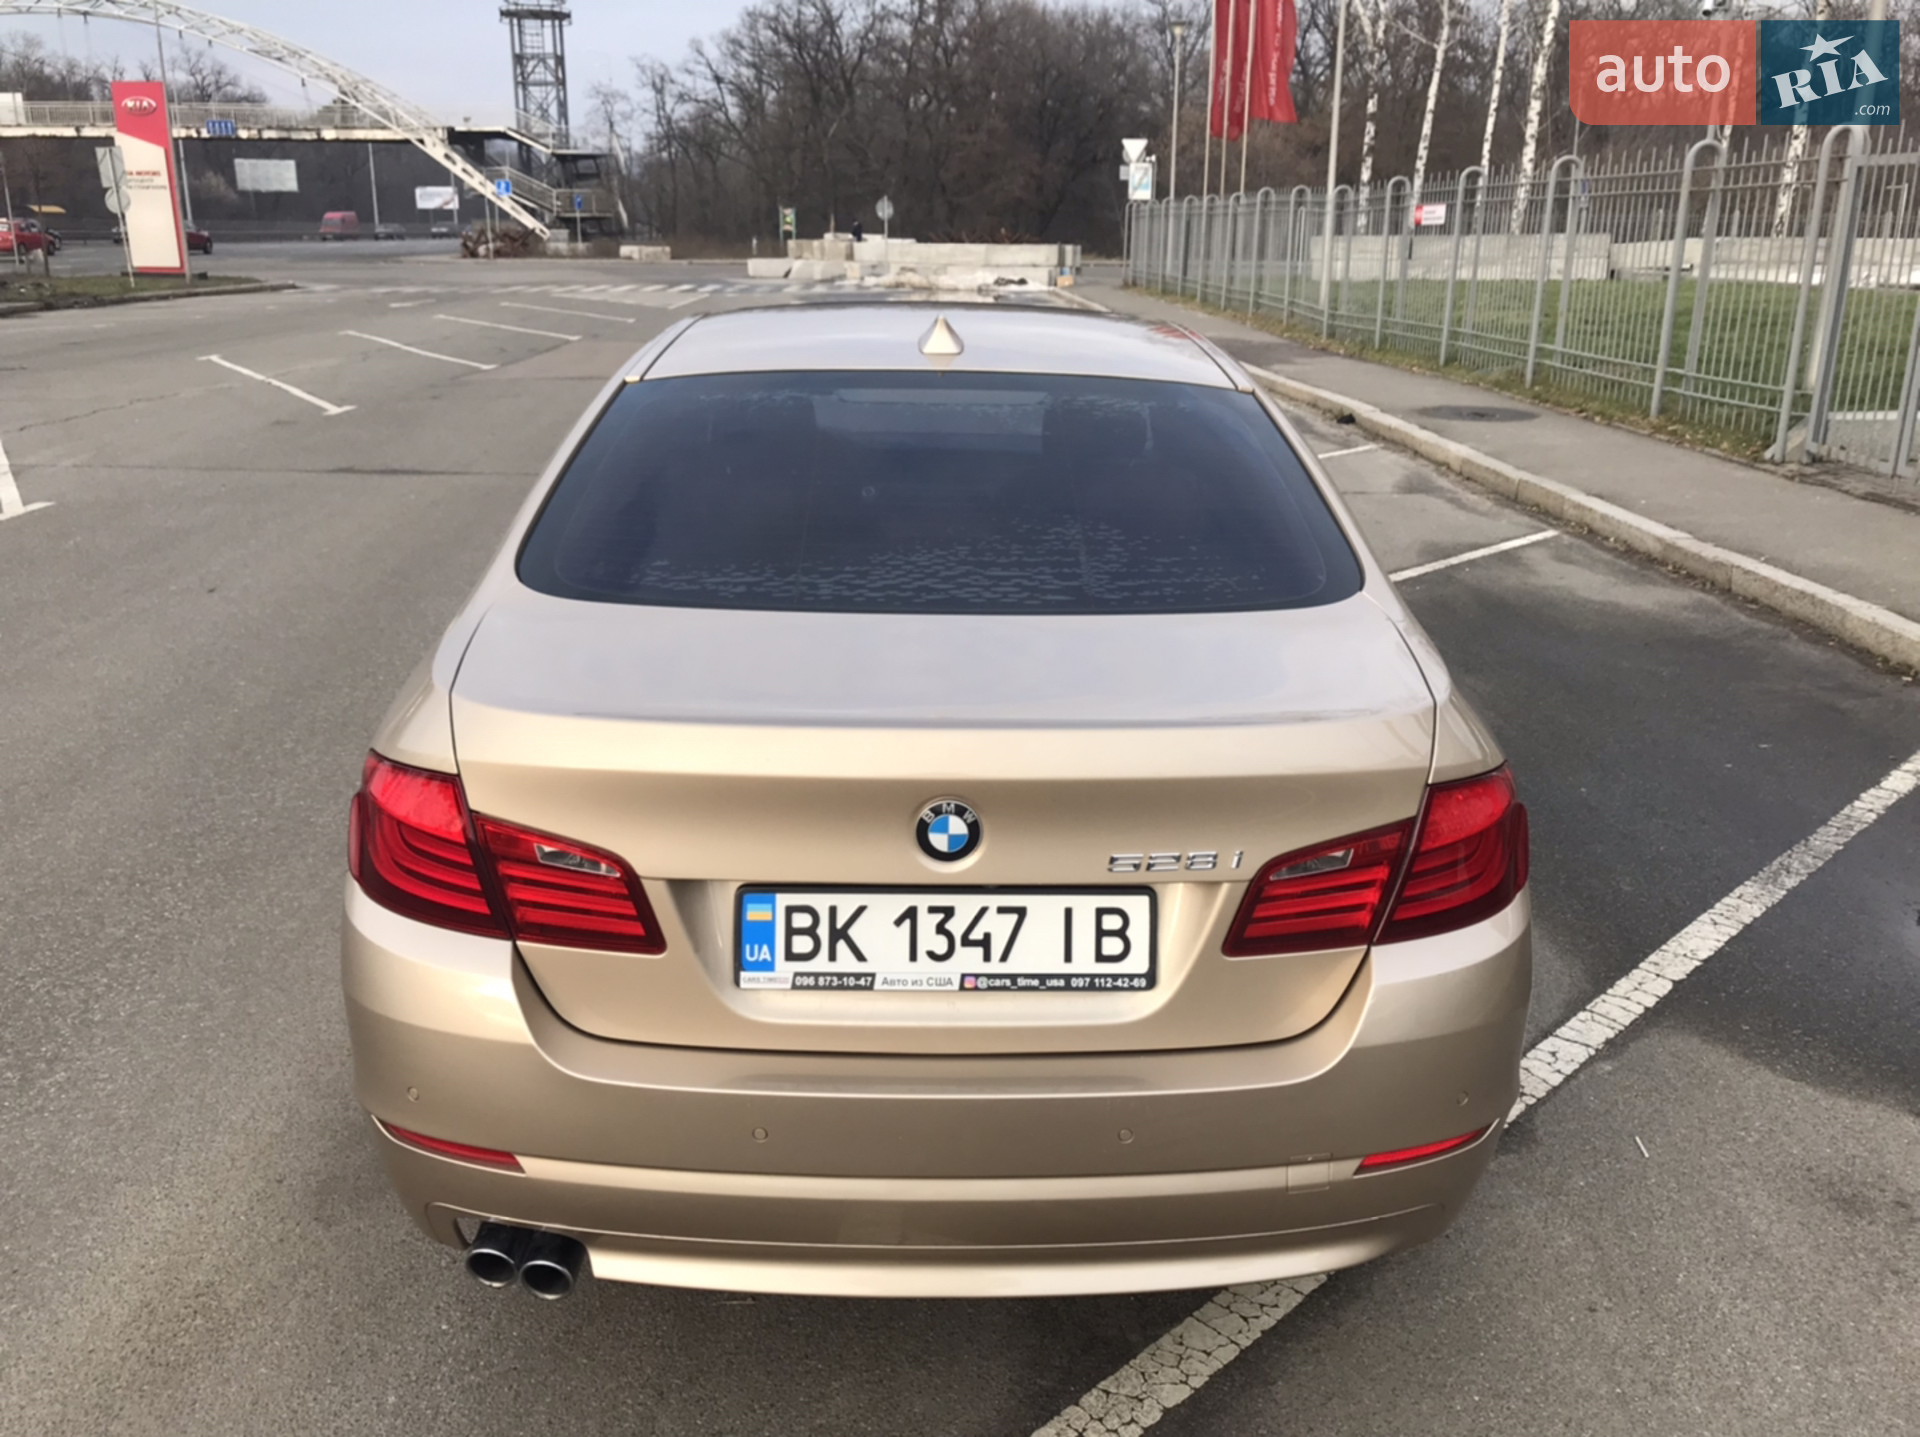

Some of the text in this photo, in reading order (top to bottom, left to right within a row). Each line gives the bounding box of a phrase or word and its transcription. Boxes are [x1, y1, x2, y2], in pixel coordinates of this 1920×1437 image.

[921, 802, 975, 824] BMW
[784, 905, 868, 962] BK
[893, 905, 1027, 963] 1347
[745, 943, 772, 962] UA
[795, 975, 815, 987] 096
[818, 975, 873, 987] 873-10-47
[881, 976, 954, 987] Авто из США
[976, 976, 1065, 989] @cars_time_usa
[1070, 977, 1147, 988] 097 112-42-69
